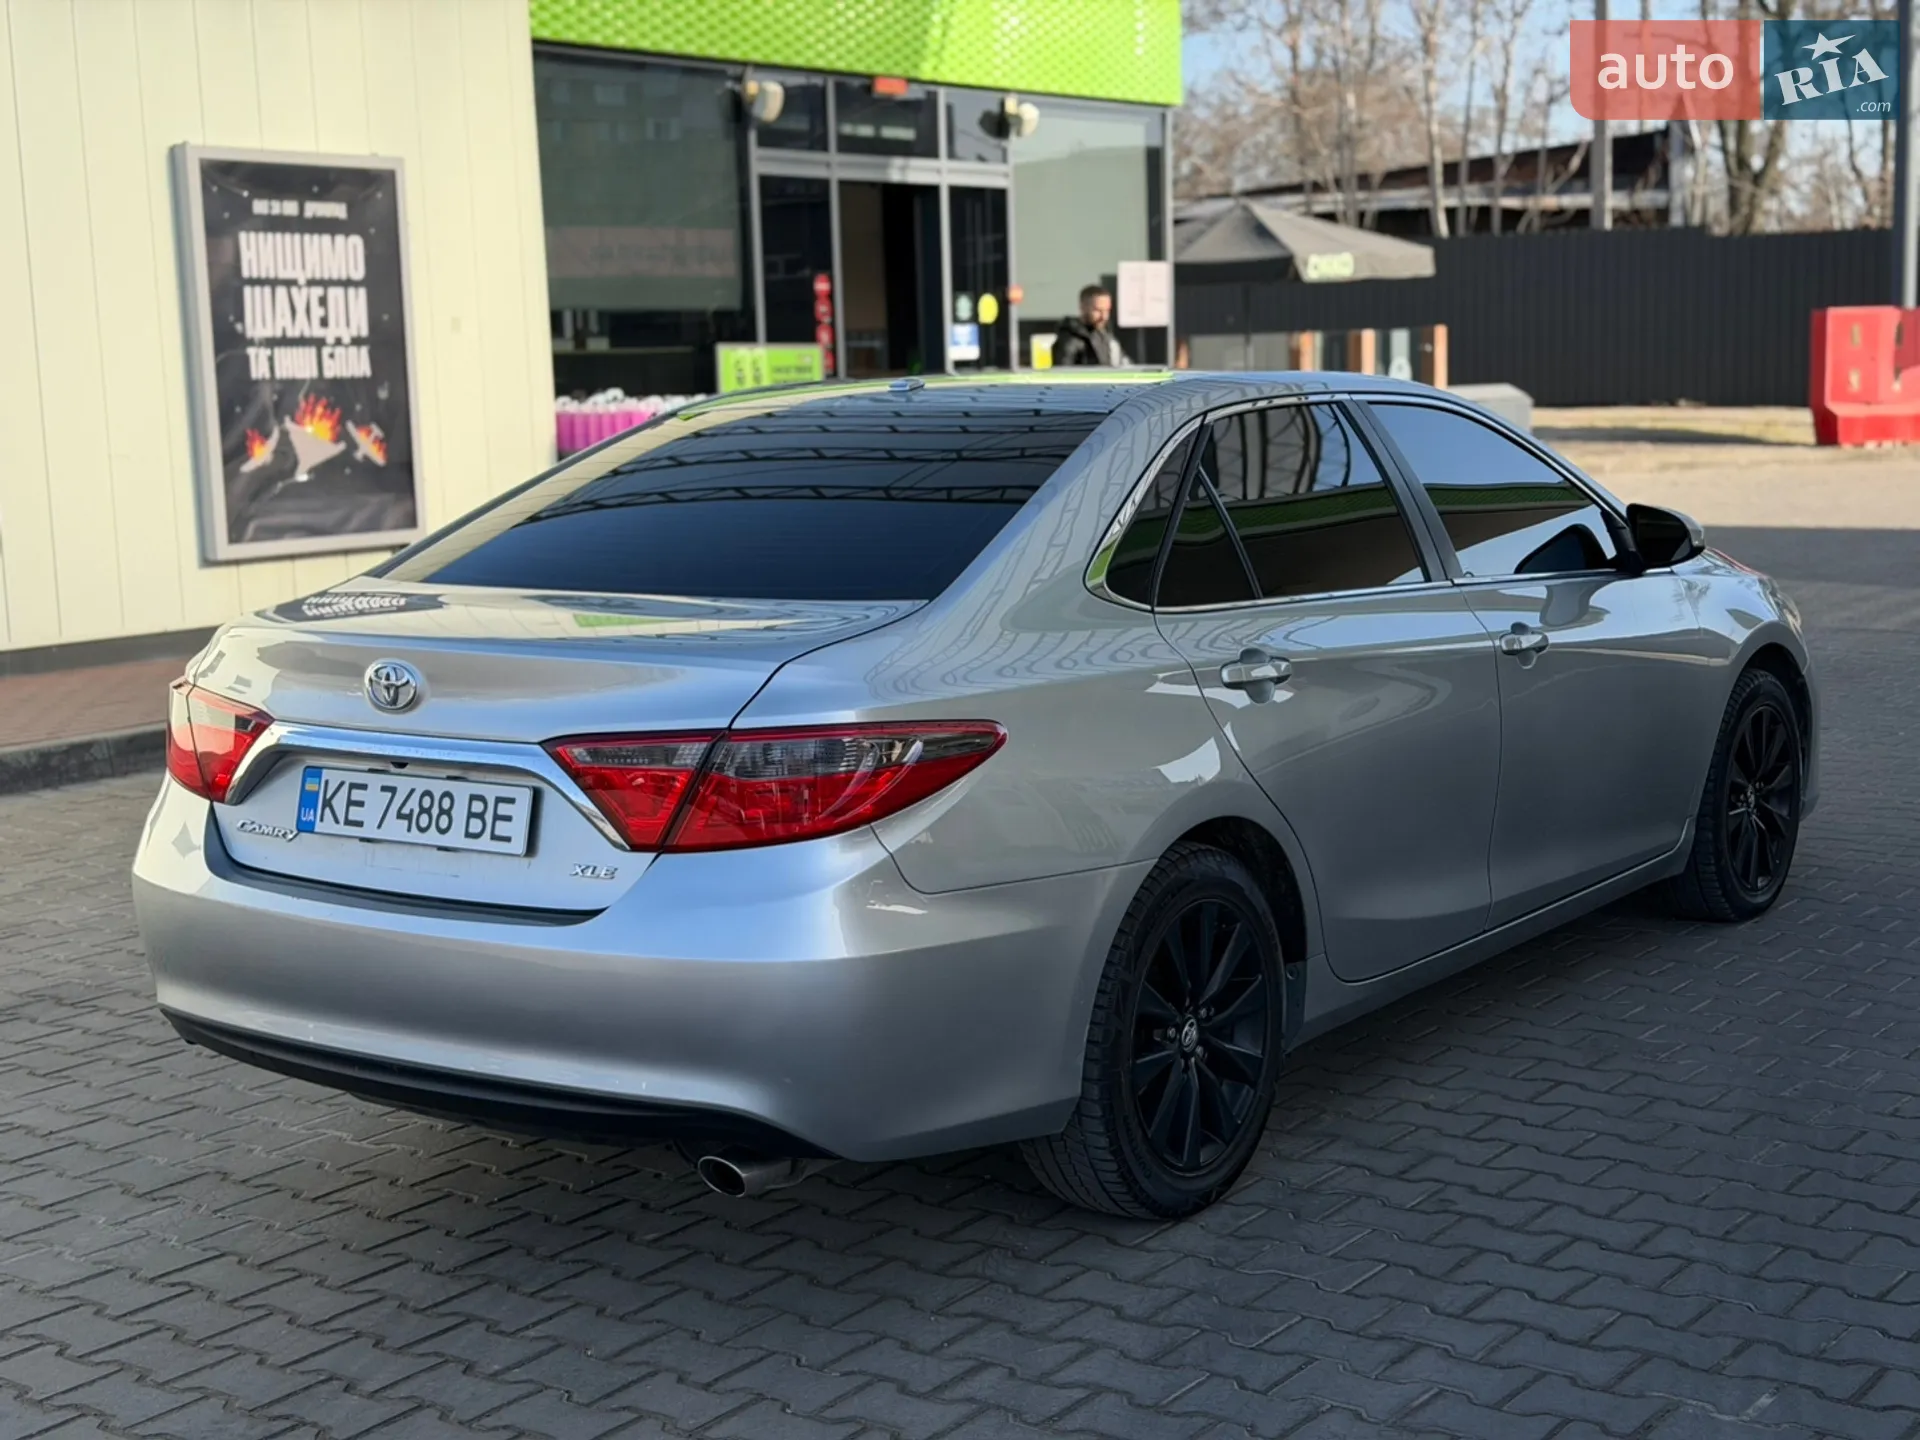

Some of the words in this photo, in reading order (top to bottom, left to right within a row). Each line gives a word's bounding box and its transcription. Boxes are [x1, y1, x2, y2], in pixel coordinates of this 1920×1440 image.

[239, 231, 366, 285] НИЩИМО
[243, 285, 369, 345] ШАХЕДИ
[301, 807, 315, 822] UA
[318, 778, 369, 828] KE
[376, 785, 455, 835] 7488
[463, 794, 517, 843] BE
[236, 819, 299, 842] CAMRY
[570, 863, 618, 880] XLE
